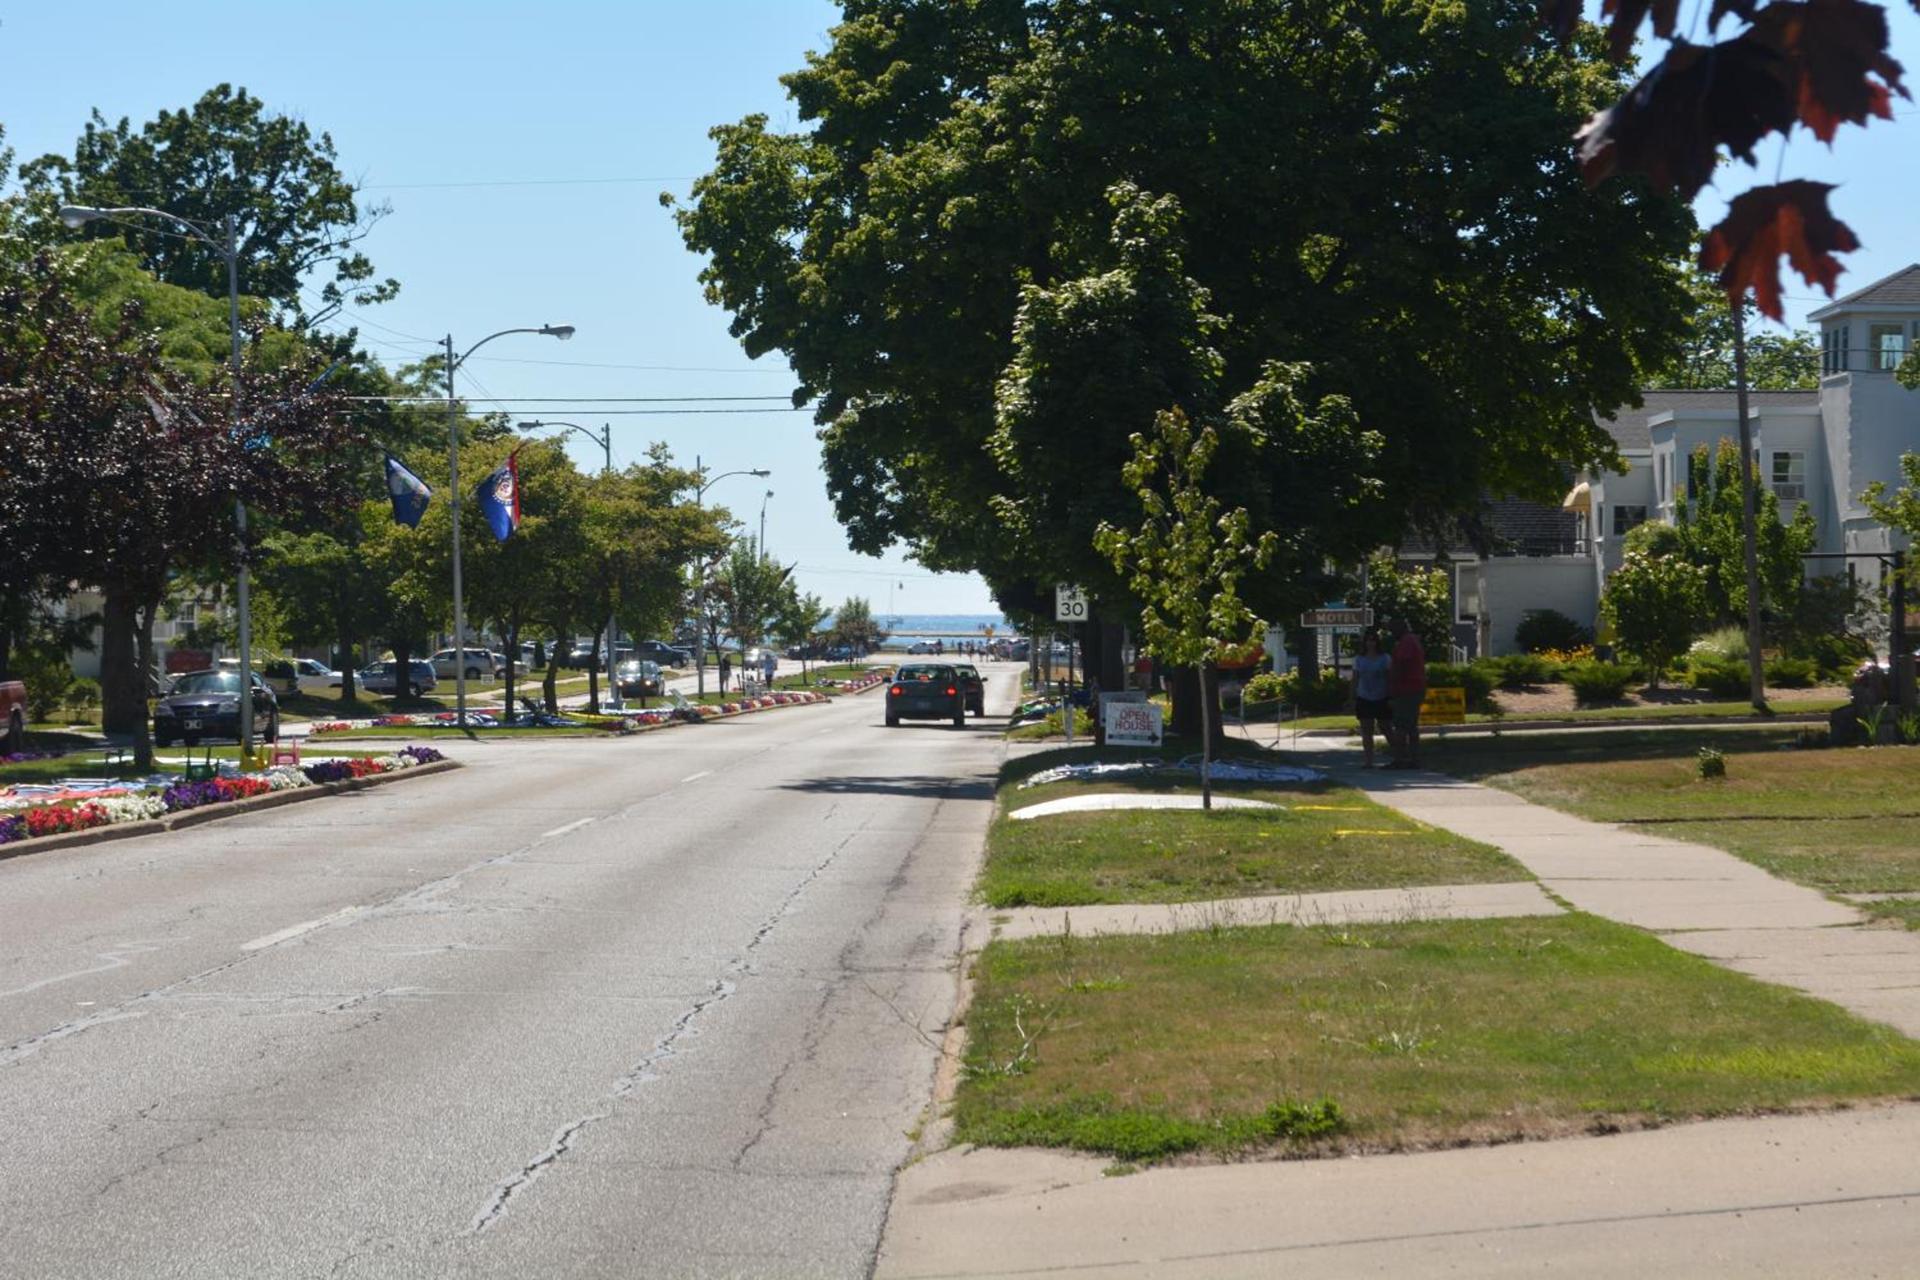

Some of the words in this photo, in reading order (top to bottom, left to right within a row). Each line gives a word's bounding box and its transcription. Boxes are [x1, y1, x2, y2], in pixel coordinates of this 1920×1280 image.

[1061, 602, 1084, 616] 30
[1316, 613, 1358, 623] MOTEL
[1119, 710, 1150, 720] OPEN
[1115, 720, 1153, 731] HOUSE
